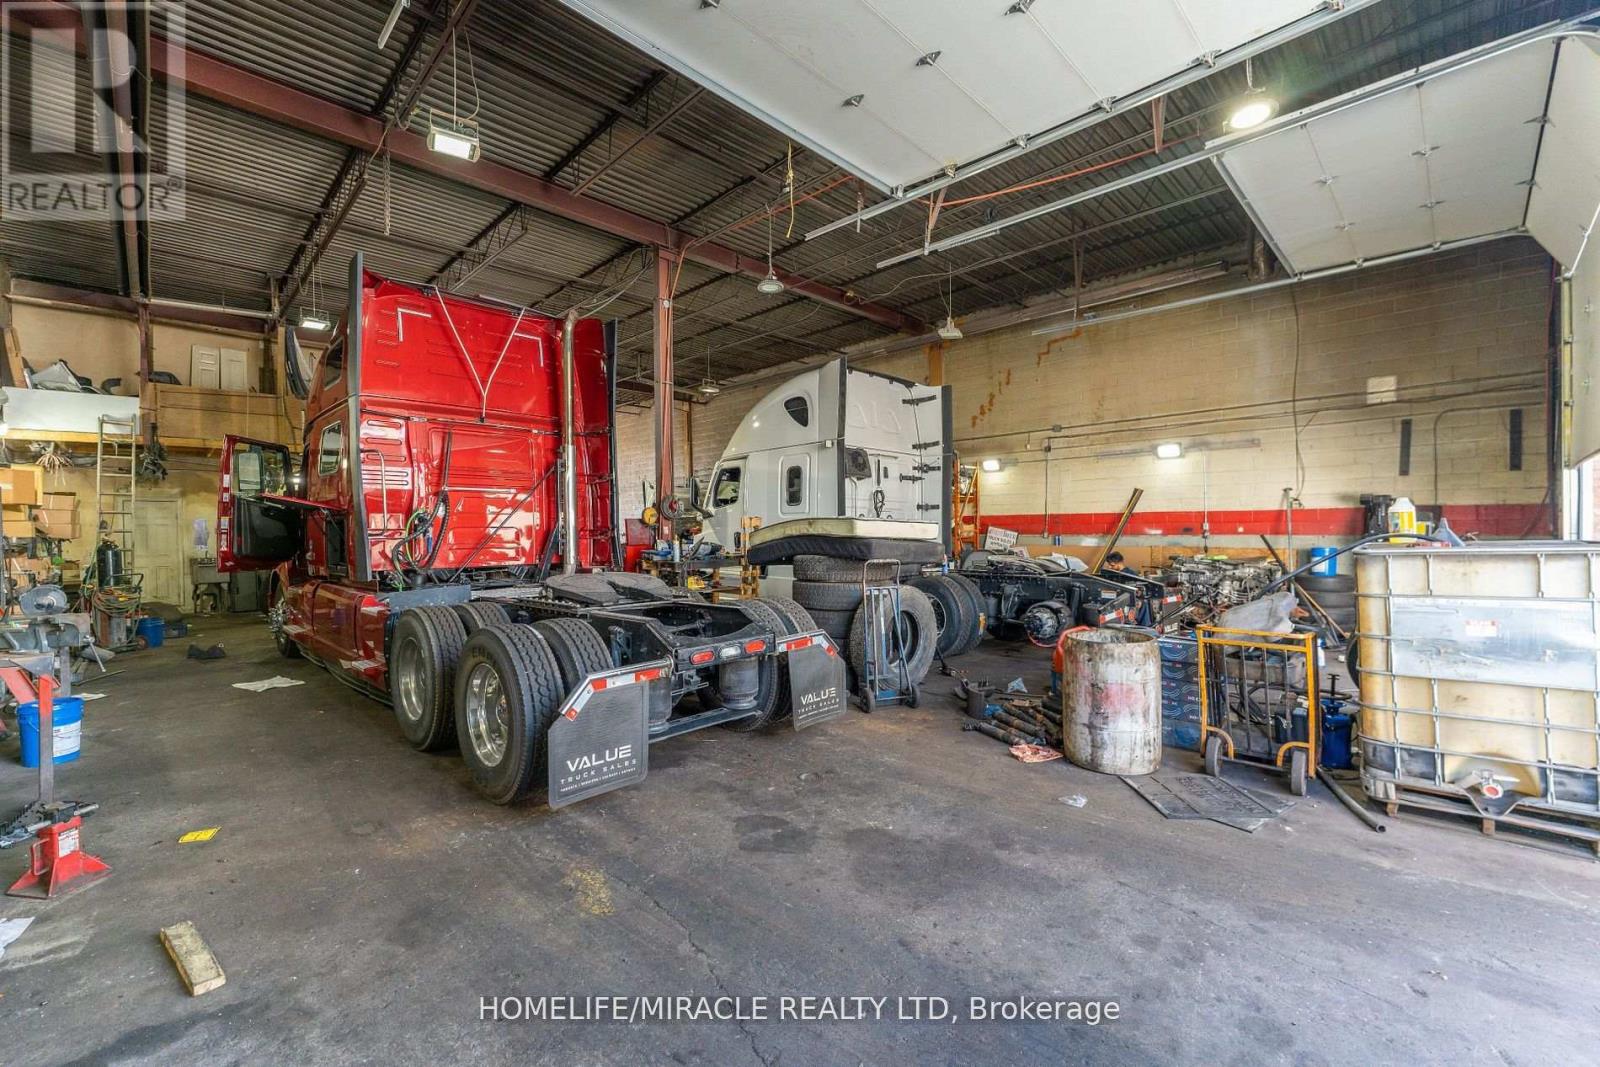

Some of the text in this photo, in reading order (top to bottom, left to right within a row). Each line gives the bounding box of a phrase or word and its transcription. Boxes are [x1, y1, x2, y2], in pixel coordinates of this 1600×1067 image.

[800, 687, 836, 705] VALUE
[560, 769, 596, 785] TRUCK
[602, 758, 637, 773] SALES
[566, 745, 632, 772] VALUE
